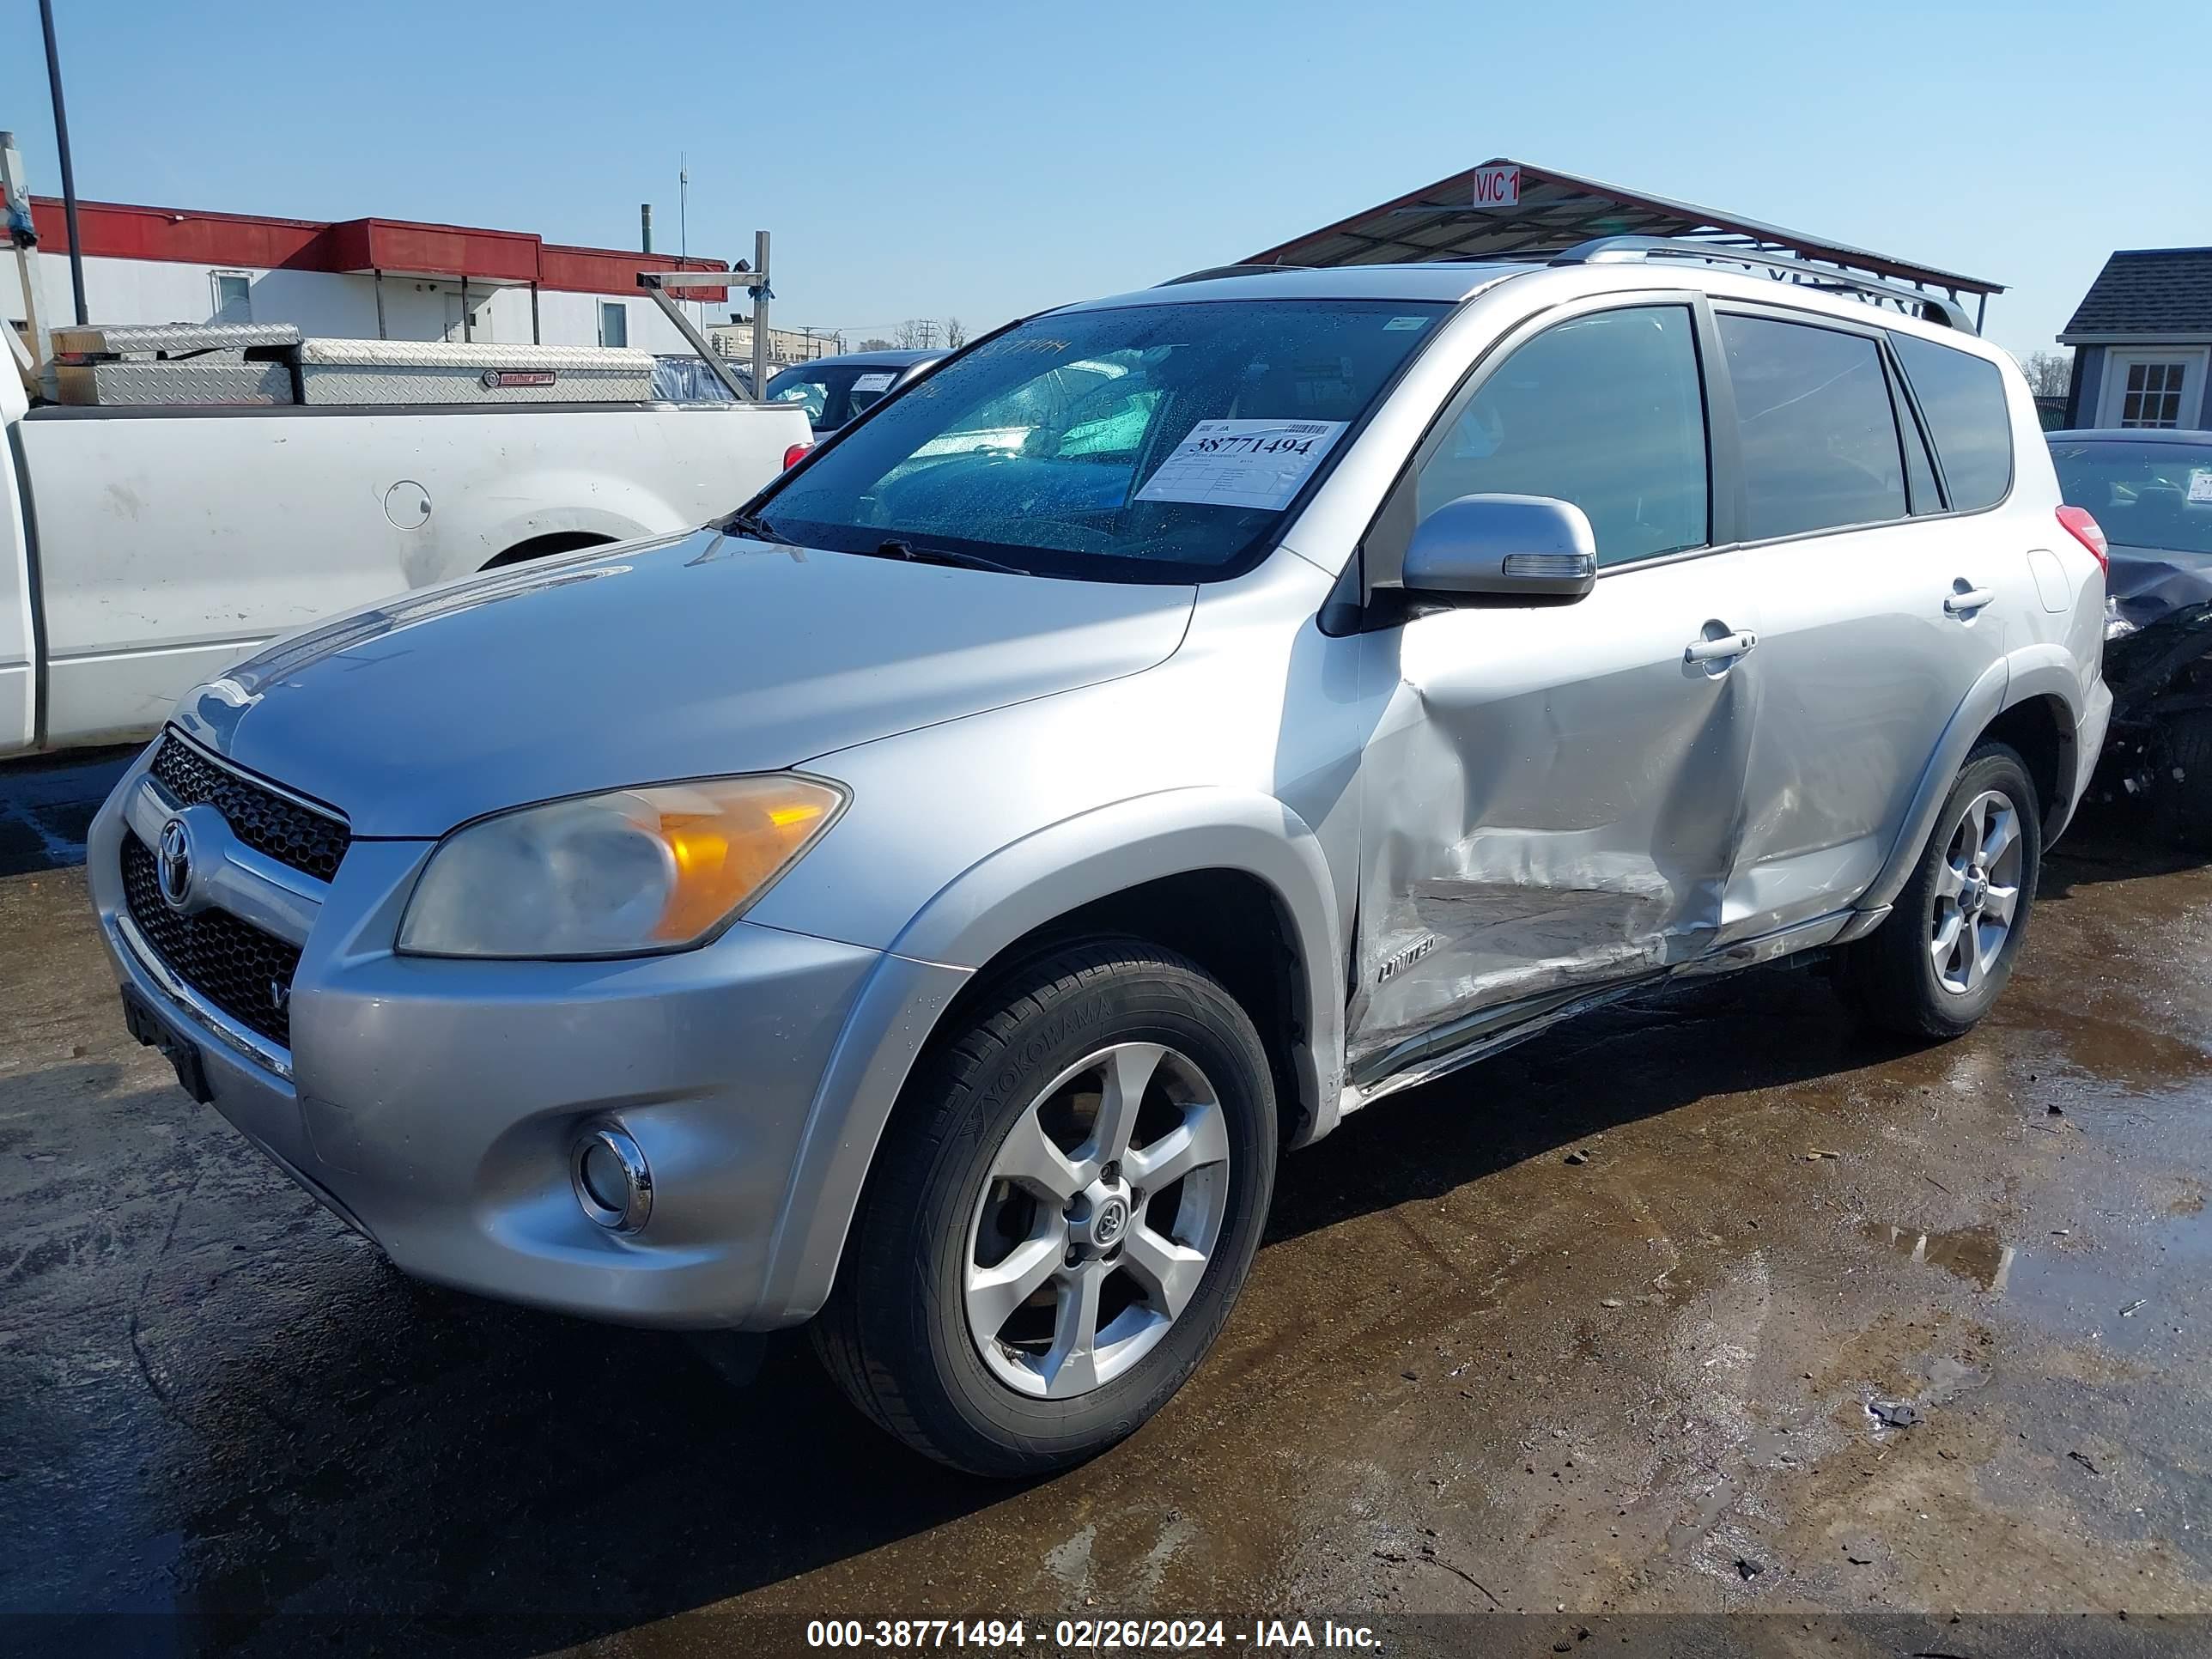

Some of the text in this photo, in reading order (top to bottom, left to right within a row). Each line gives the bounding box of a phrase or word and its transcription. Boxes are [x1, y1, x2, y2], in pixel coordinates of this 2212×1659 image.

[1476, 170, 1519, 202] VIC 1
[502, 374, 552, 383] weather guard
[1189, 437, 1314, 455] 38771494
[1377, 934, 1436, 983] LIMITED
[984, 994, 1114, 1106] YOKOHAMA
